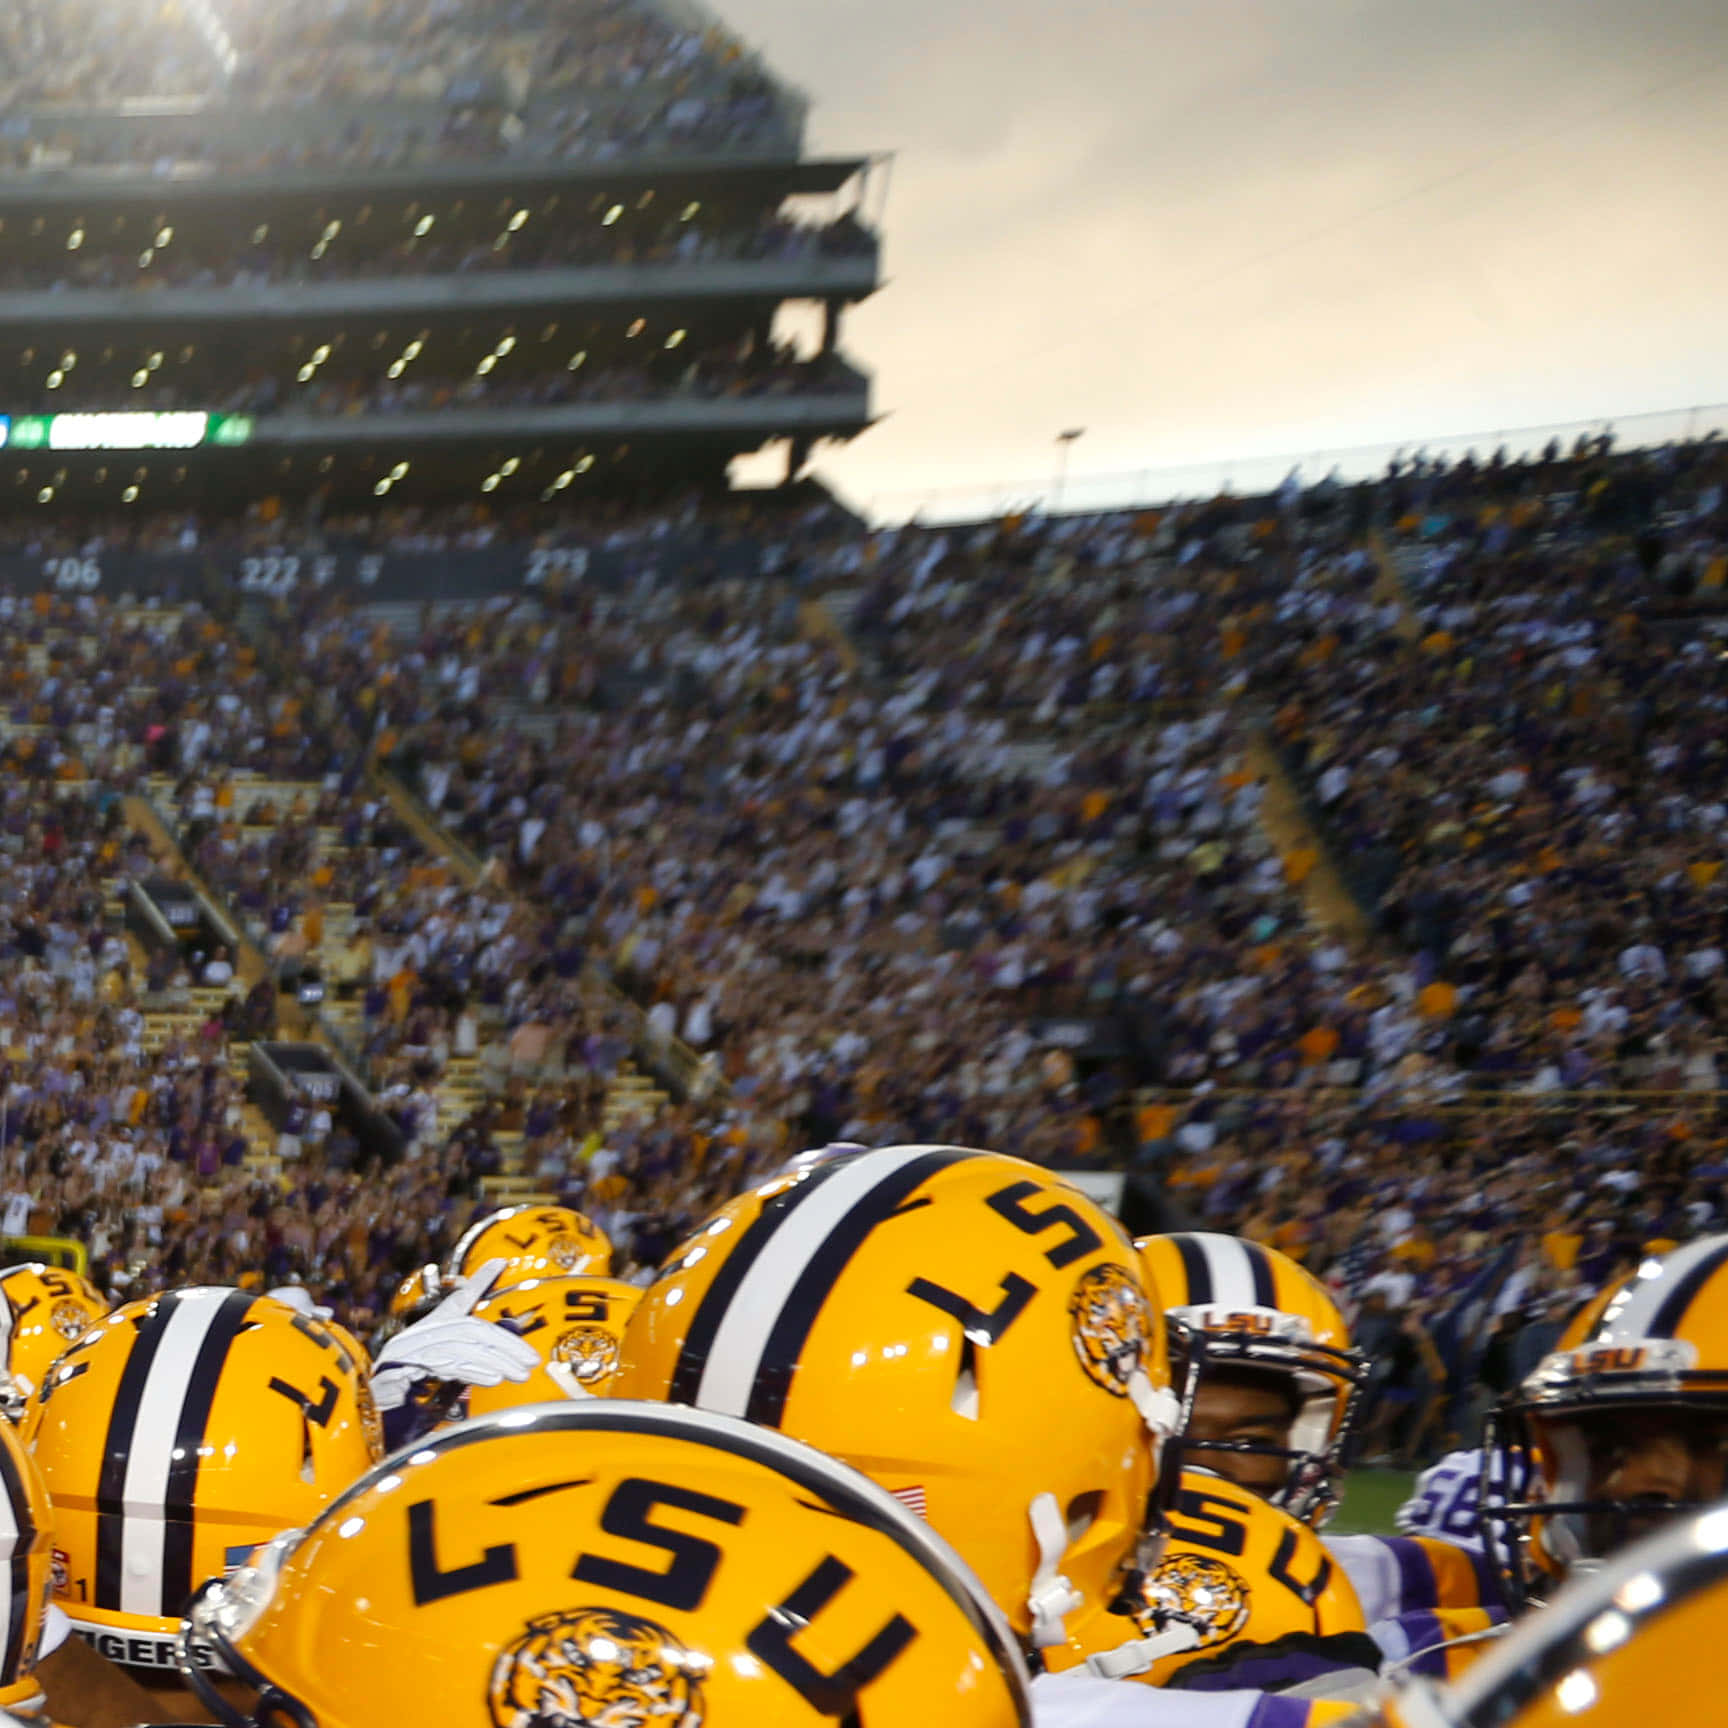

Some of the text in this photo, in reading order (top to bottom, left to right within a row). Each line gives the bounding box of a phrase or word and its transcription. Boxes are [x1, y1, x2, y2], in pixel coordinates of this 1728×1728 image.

[906, 1180, 1104, 1347] LS
[1203, 1311, 1273, 1336] LSU
[1569, 1347, 1646, 1375] LSU
[1169, 1488, 1333, 1606] SU
[408, 1476, 921, 1717] LSU
[72, 1628, 212, 1667] GERS
